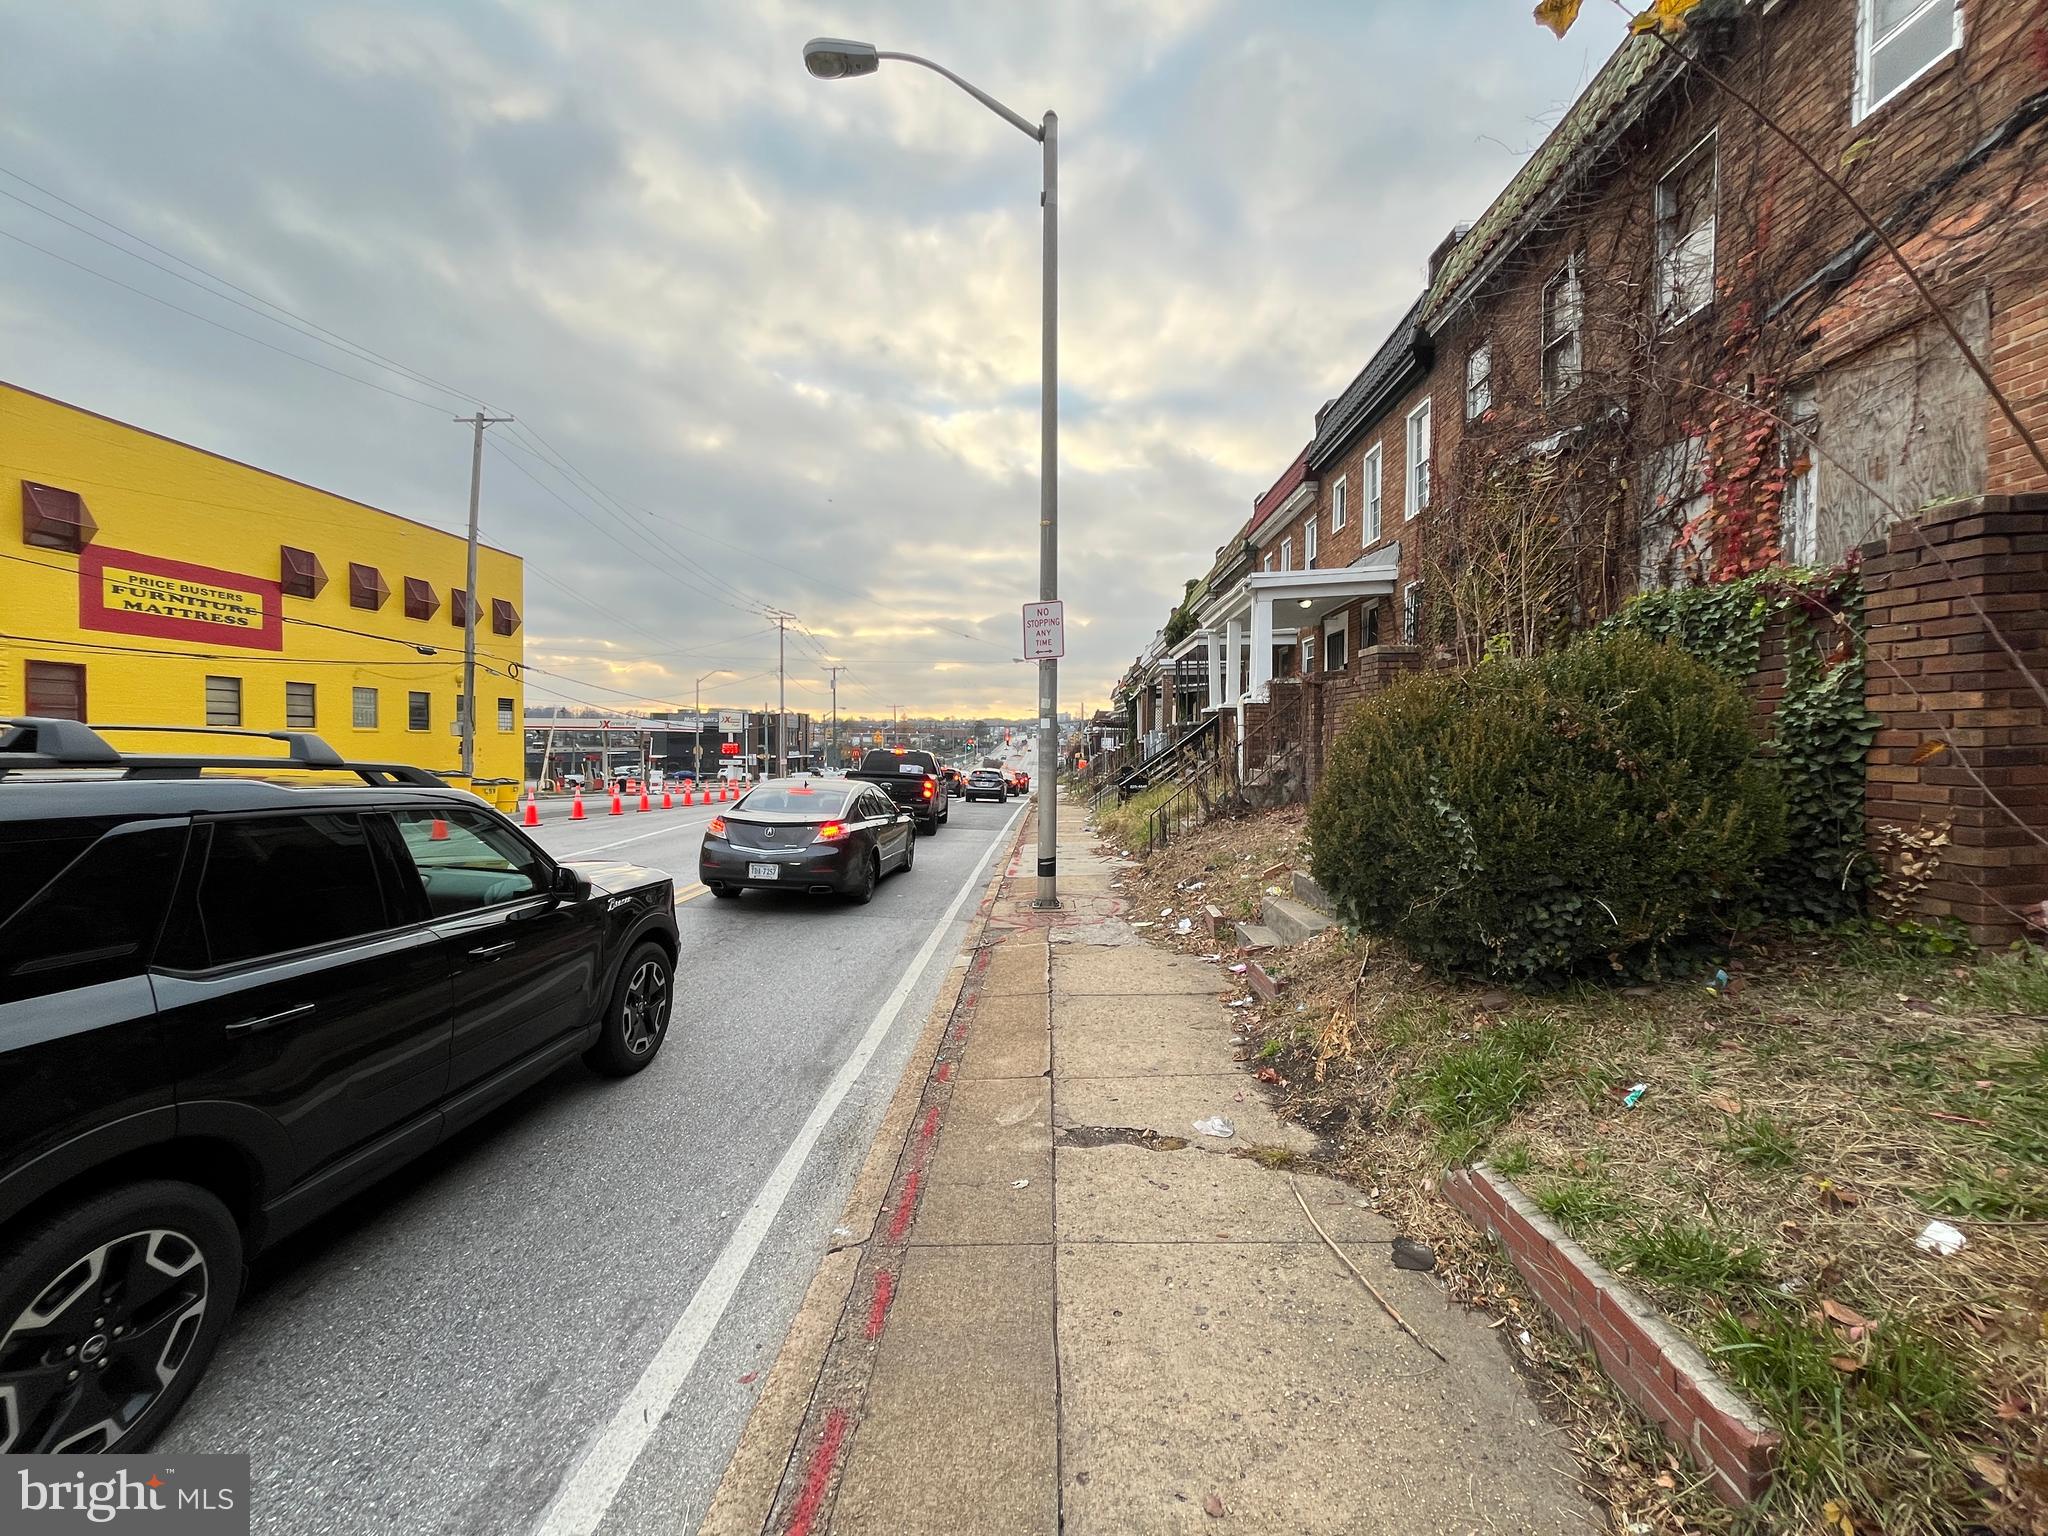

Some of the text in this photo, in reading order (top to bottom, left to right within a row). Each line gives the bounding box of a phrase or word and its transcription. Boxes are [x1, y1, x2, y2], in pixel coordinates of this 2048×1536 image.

[111, 584, 258, 616] FURNITURE
[129, 575, 243, 602] PRICE BUSTERS
[123, 600, 249, 626] MATTRESS
[1027, 618, 1060, 628] STOPPING
[1037, 608, 1049, 616] NO
